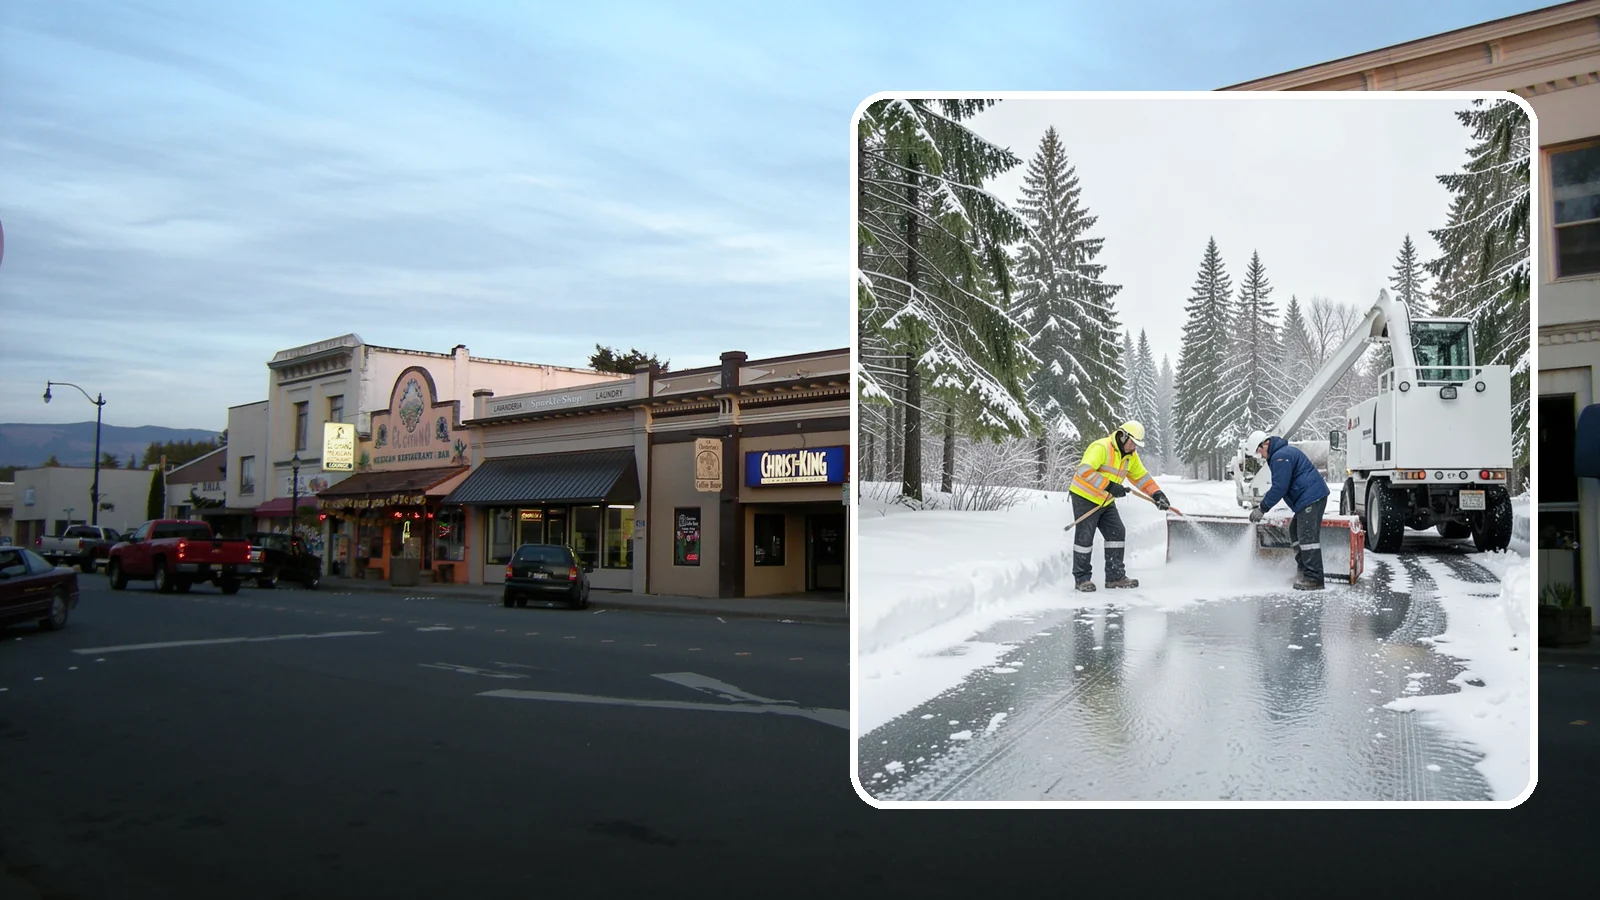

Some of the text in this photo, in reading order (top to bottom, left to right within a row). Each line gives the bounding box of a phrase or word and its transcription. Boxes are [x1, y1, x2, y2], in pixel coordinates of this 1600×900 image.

[595, 388, 624, 400] LAUNDRY
[493, 402, 523, 413] LAVANDERIA
[530, 394, 583, 409] Sparkle Shop
[327, 450, 353, 458] MEXICAN
[397, 451, 434, 462] RESTAURANT
[438, 450, 450, 459] BAR
[799, 450, 828, 476] KING
